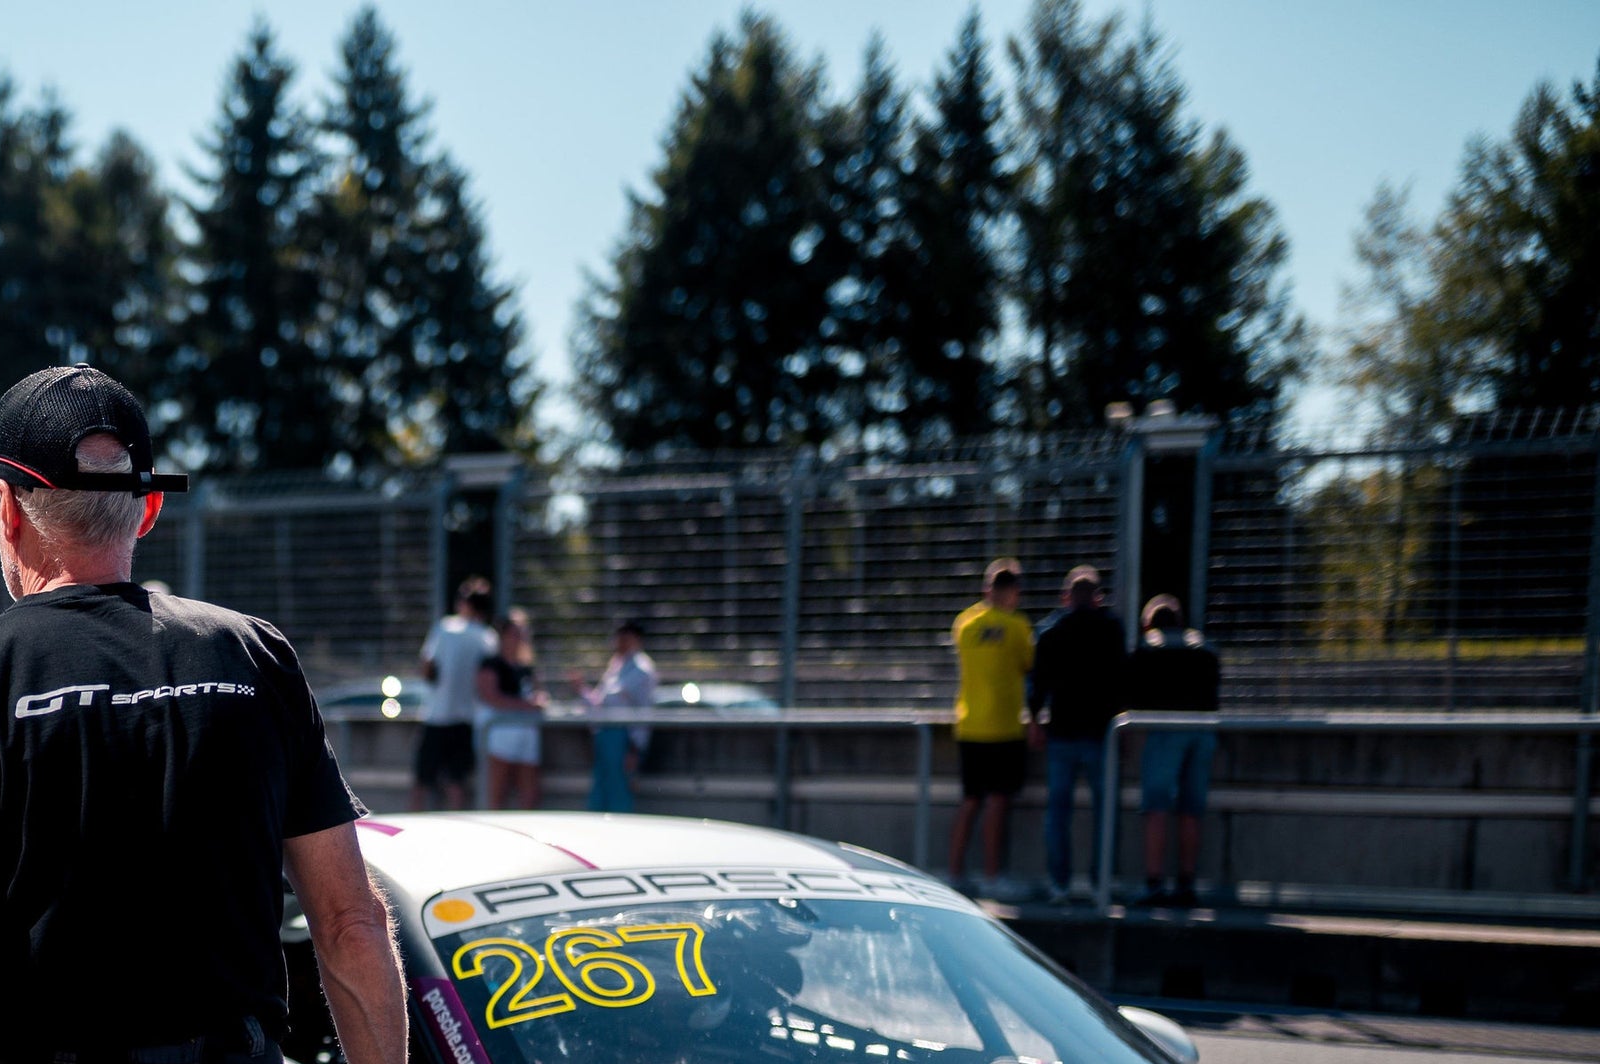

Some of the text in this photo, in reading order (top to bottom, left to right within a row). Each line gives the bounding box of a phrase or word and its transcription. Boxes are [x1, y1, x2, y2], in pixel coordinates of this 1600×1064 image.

[15, 682, 236, 718] GT SPORTS
[474, 870, 972, 915] PORSCHE
[452, 922, 717, 1030] 267
